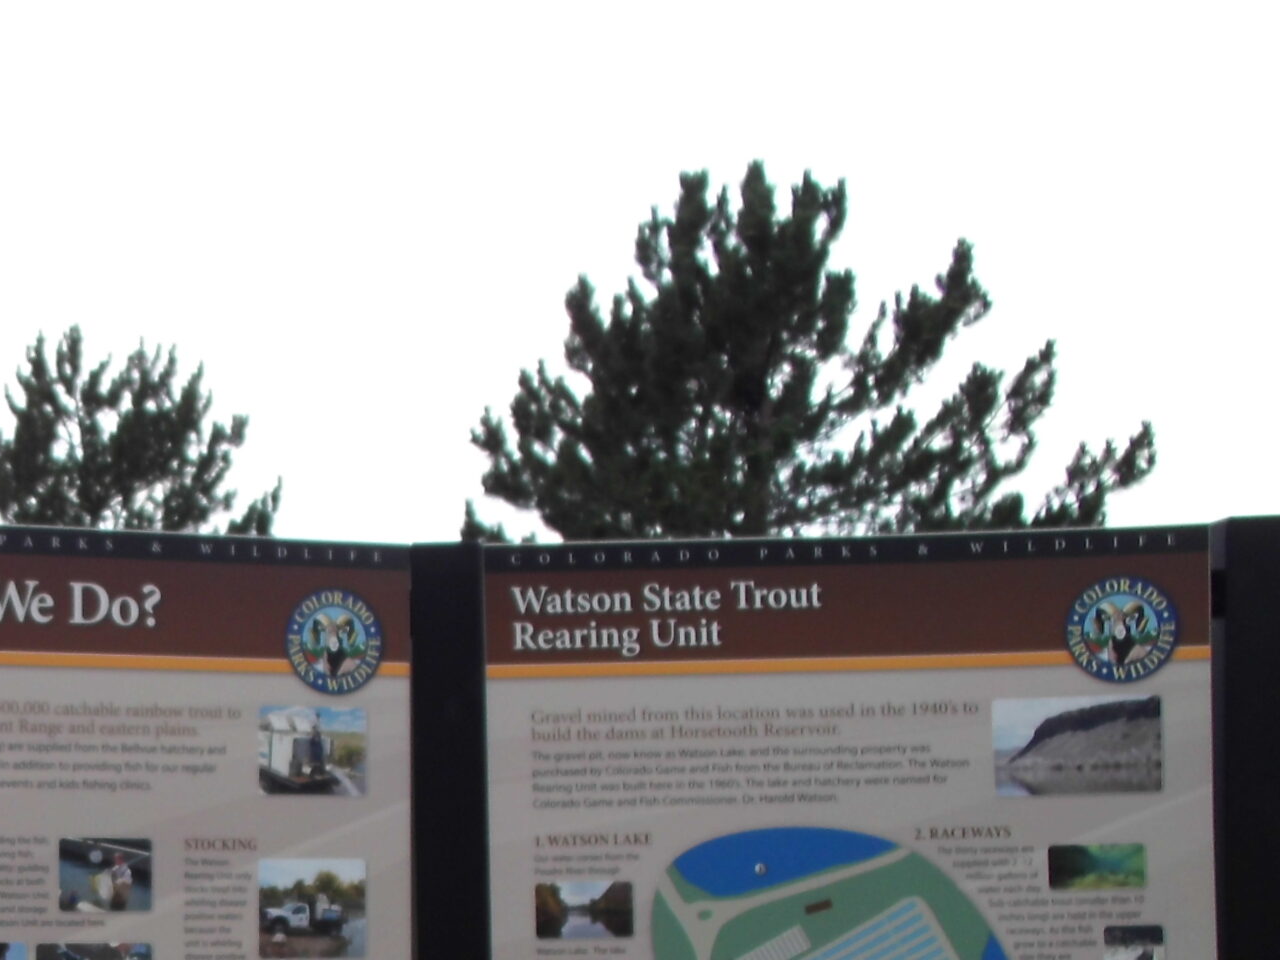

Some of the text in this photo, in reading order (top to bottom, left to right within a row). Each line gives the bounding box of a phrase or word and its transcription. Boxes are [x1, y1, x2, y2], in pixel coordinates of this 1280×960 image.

[199, 544, 381, 563] WILDLIFE
[511, 548, 719, 565] COLORADO
[759, 546, 877, 559] PARKS
[970, 533, 1176, 555] WILDLIFE
[69, 582, 162, 627] Do?
[292, 590, 374, 626] COLORADO
[511, 581, 823, 616] Watson State Trout
[1074, 579, 1167, 614] COLORADO
[512, 621, 721, 655] Rearing Unit
[1067, 623, 1098, 675] PARKS
[1112, 623, 1176, 680] WILDLIFE
[288, 636, 316, 684] PARKS
[325, 638, 381, 692] WILDLIFE
[53, 701, 121, 716] catchable
[124, 702, 184, 718] rainbow
[187, 704, 224, 719] trout
[226, 705, 242, 719] to
[530, 700, 980, 724] Gravel mined from this location was used in the 1940's to
[17, 718, 63, 739] Range
[67, 719, 96, 734] and
[98, 721, 151, 735] eastern
[530, 727, 572, 742] build
[576, 726, 601, 741] the
[604, 726, 647, 741] dams
[650, 726, 665, 740] at
[669, 722, 758, 739] Horsetooth
[185, 838, 257, 852] STOCKING
[548, 833, 609, 847] WATSON
[613, 832, 652, 846] LAKE
[929, 825, 1012, 839] RACEWAYS
